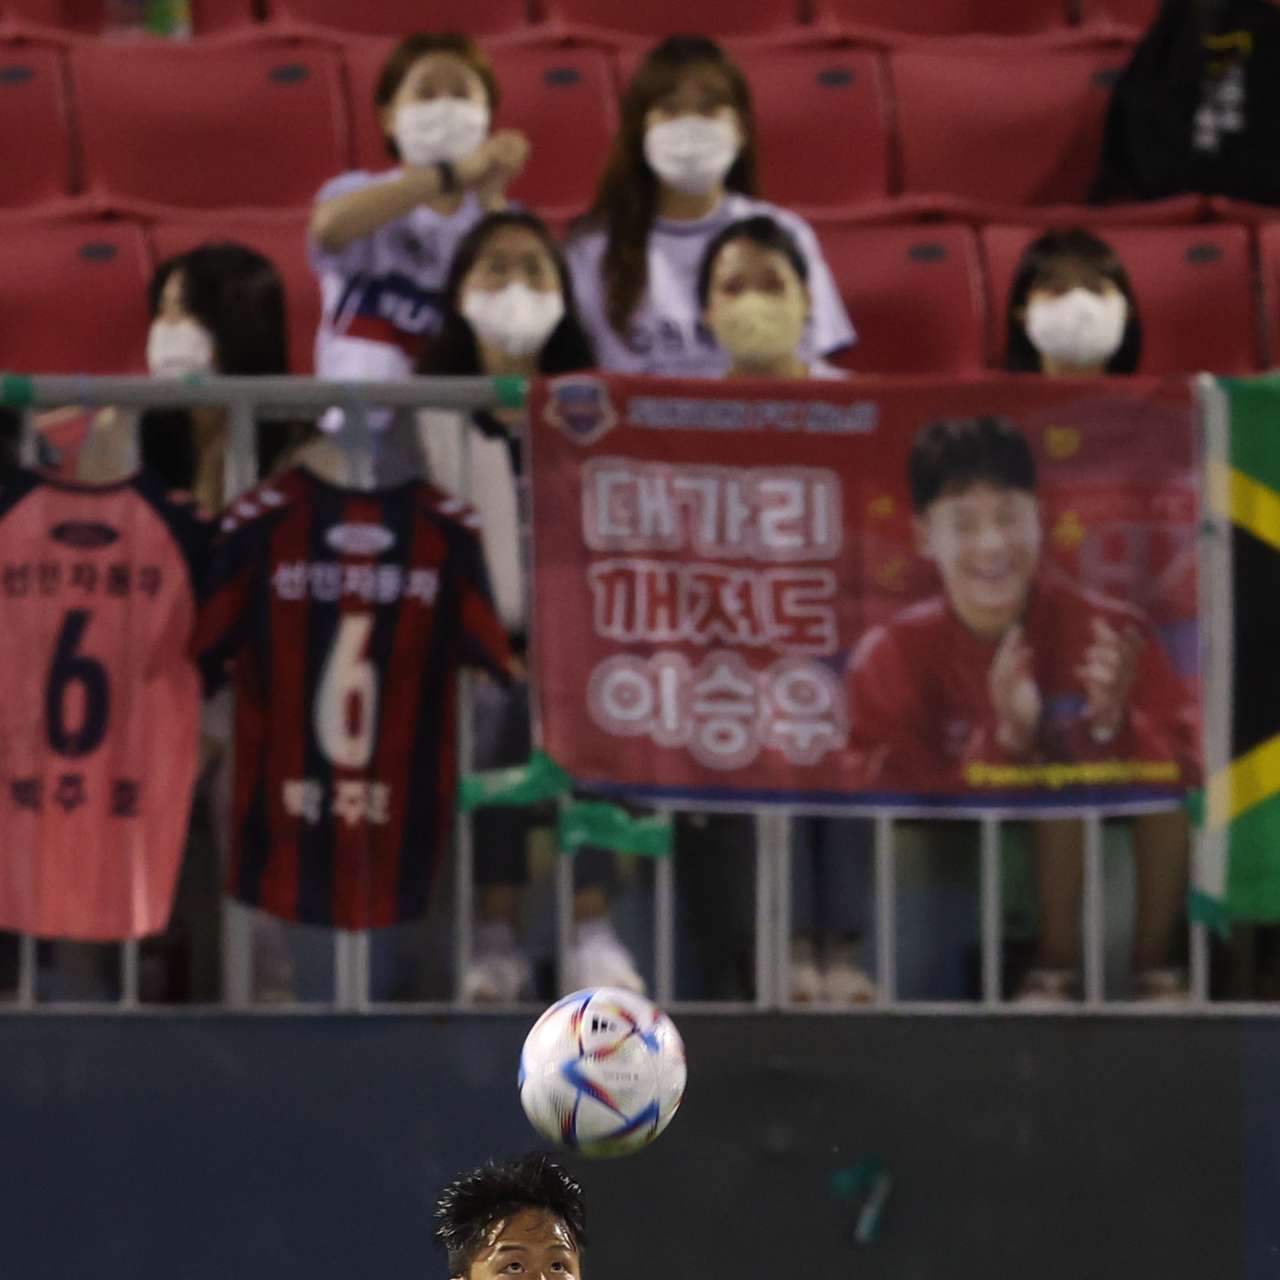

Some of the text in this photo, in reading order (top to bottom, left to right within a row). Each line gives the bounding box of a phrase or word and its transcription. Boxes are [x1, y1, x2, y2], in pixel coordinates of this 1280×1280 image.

[586, 461, 840, 559] 대가리
[44, 609, 110, 759] 6
[314, 612, 379, 768] 6
[588, 654, 847, 768] 이승우
